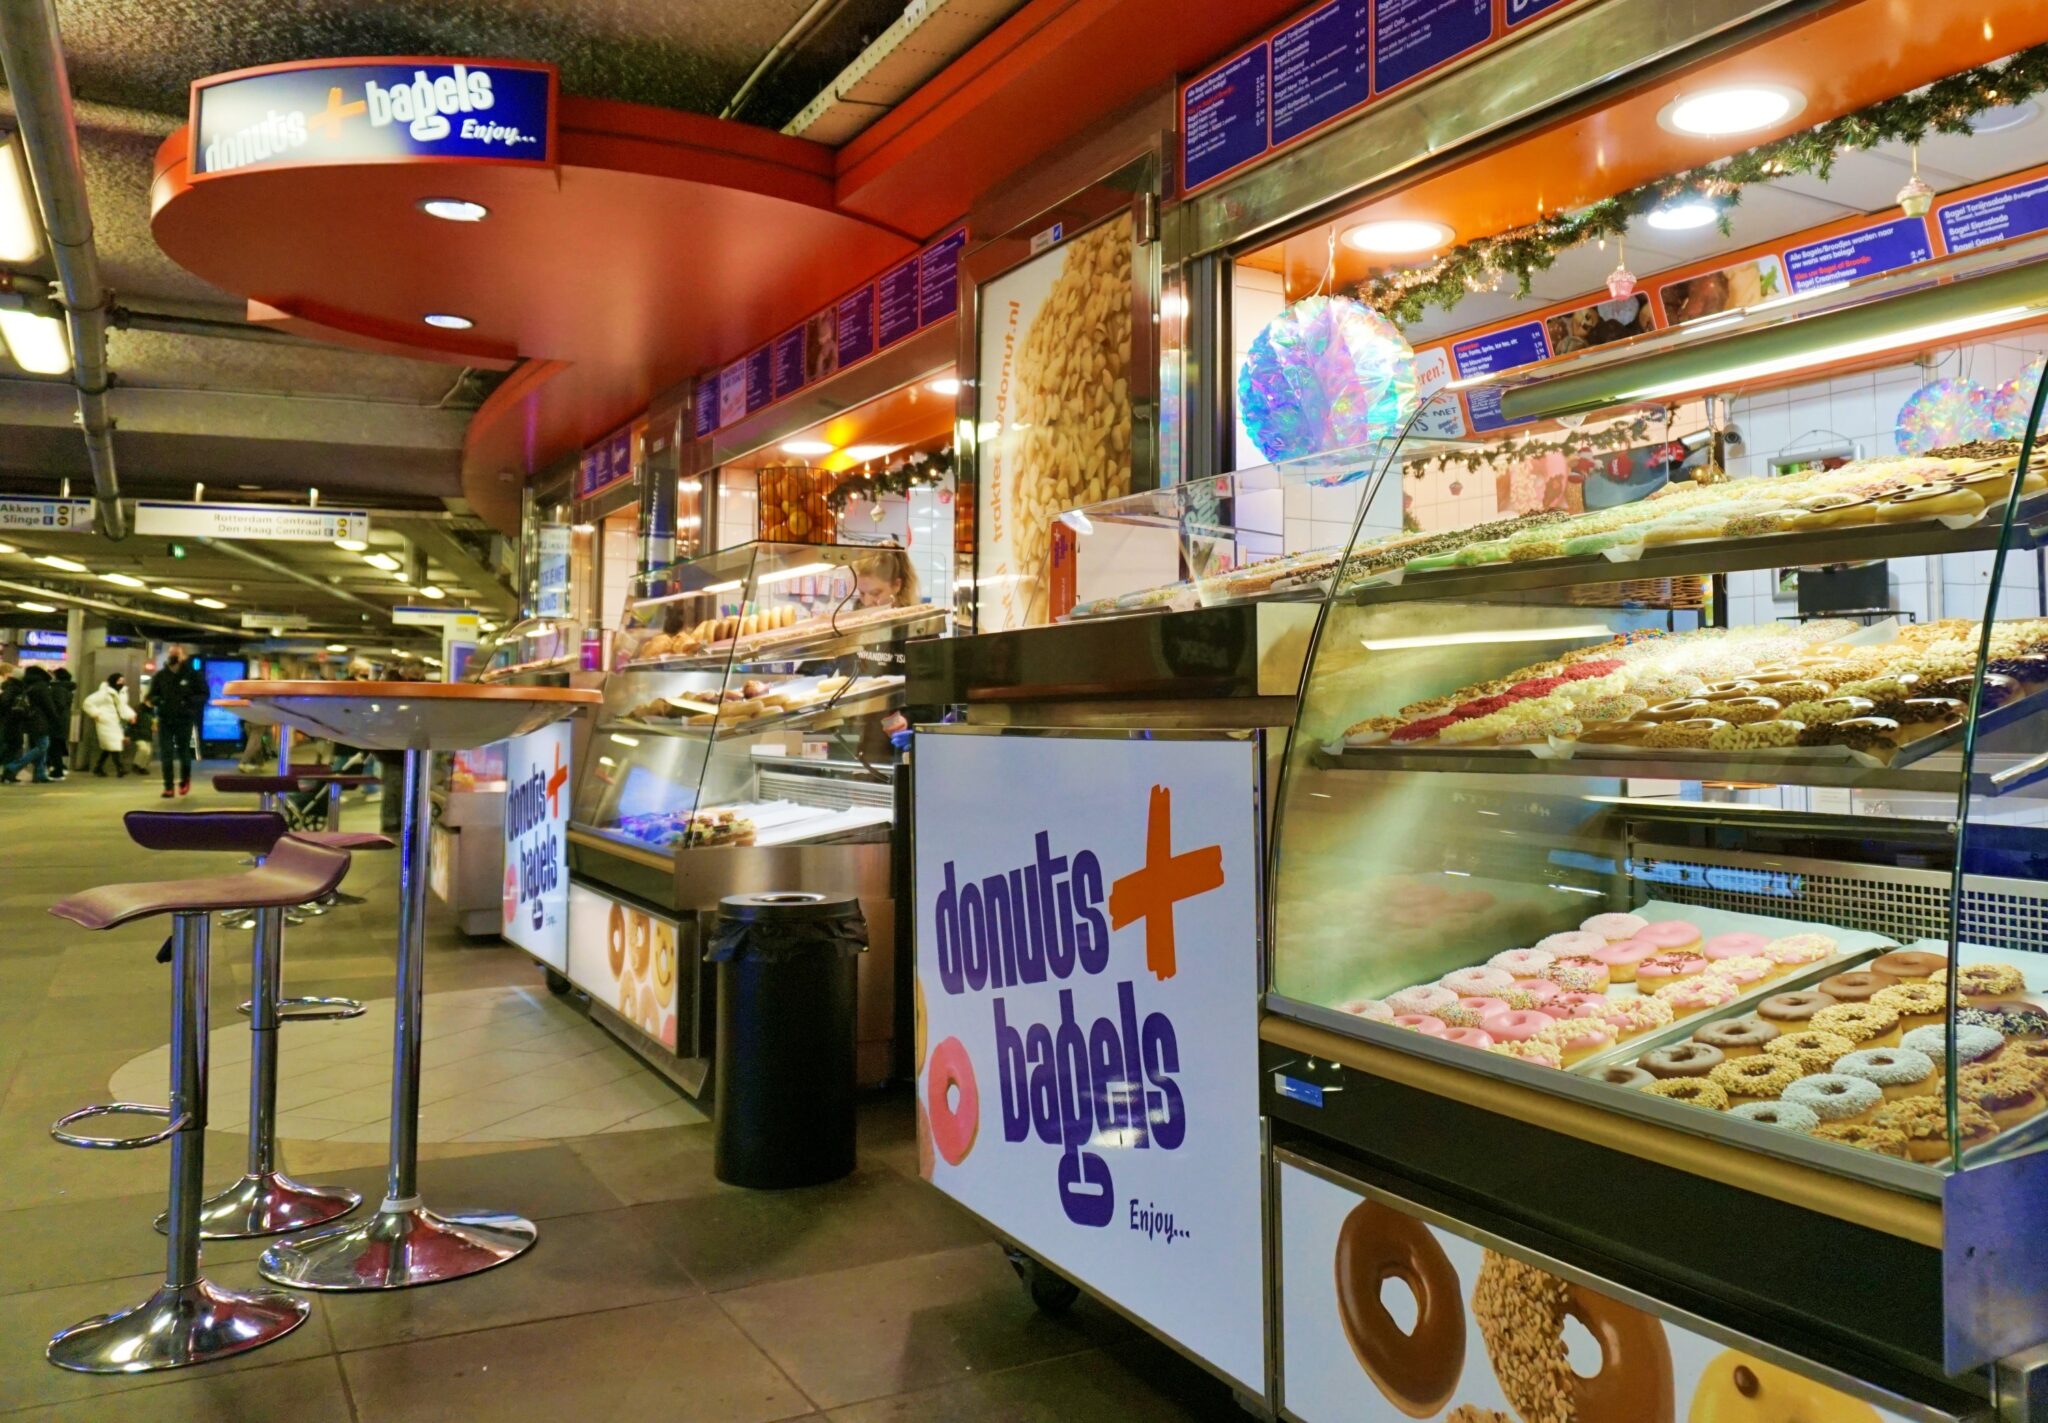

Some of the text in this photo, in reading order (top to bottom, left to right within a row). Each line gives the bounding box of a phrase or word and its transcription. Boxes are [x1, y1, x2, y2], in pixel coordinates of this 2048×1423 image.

[204, 109, 308, 173] donuts
[366, 64, 495, 142] bagels
[1945, 206, 1966, 219] Bagel
[1948, 223, 1970, 236] Bagel
[0, 503, 41, 514] Akkers
[3, 514, 40, 526] Slinge
[213, 514, 322, 526] Rotterdam Centraal
[218, 524, 321, 537] Den Haag Centraal
[507, 762, 547, 842] donuts
[519, 823, 558, 931] bagels
[935, 830, 1109, 995] donuts
[992, 980, 1186, 1228] bagels
[1129, 1198, 1191, 1244] Enjoy...
